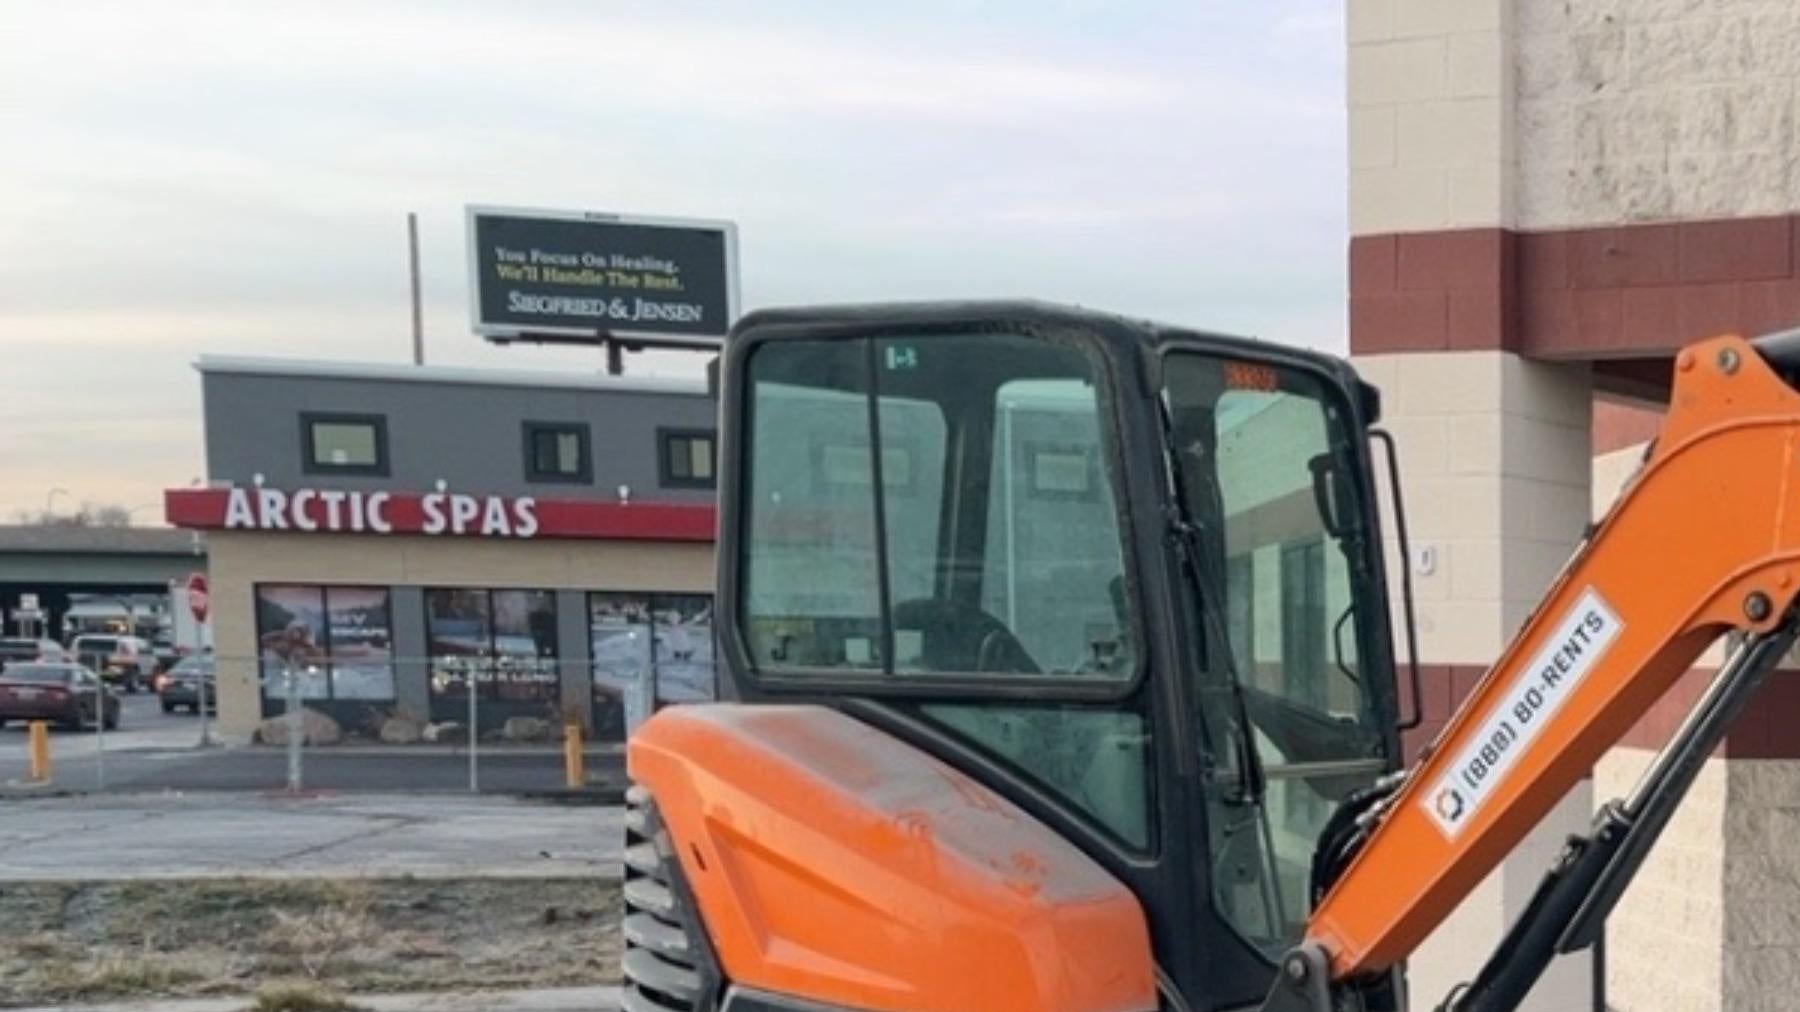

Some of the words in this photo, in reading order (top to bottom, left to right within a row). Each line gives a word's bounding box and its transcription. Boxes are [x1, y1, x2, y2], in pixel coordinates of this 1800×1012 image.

[495, 246, 526, 263] You
[531, 248, 579, 267] Focus
[582, 252, 607, 268] On
[496, 264, 539, 282] We'll
[542, 266, 603, 287] Handle
[606, 271, 639, 289] The
[507, 289, 607, 317] SIEGFRIED
[608, 297, 629, 319] &
[631, 297, 703, 322] JENSEN
[224, 487, 392, 533] ARCTIC
[421, 493, 539, 538] SPAS
[1461, 720, 1518, 790] (888)
[1513, 609, 1605, 725] 80-RENTS
